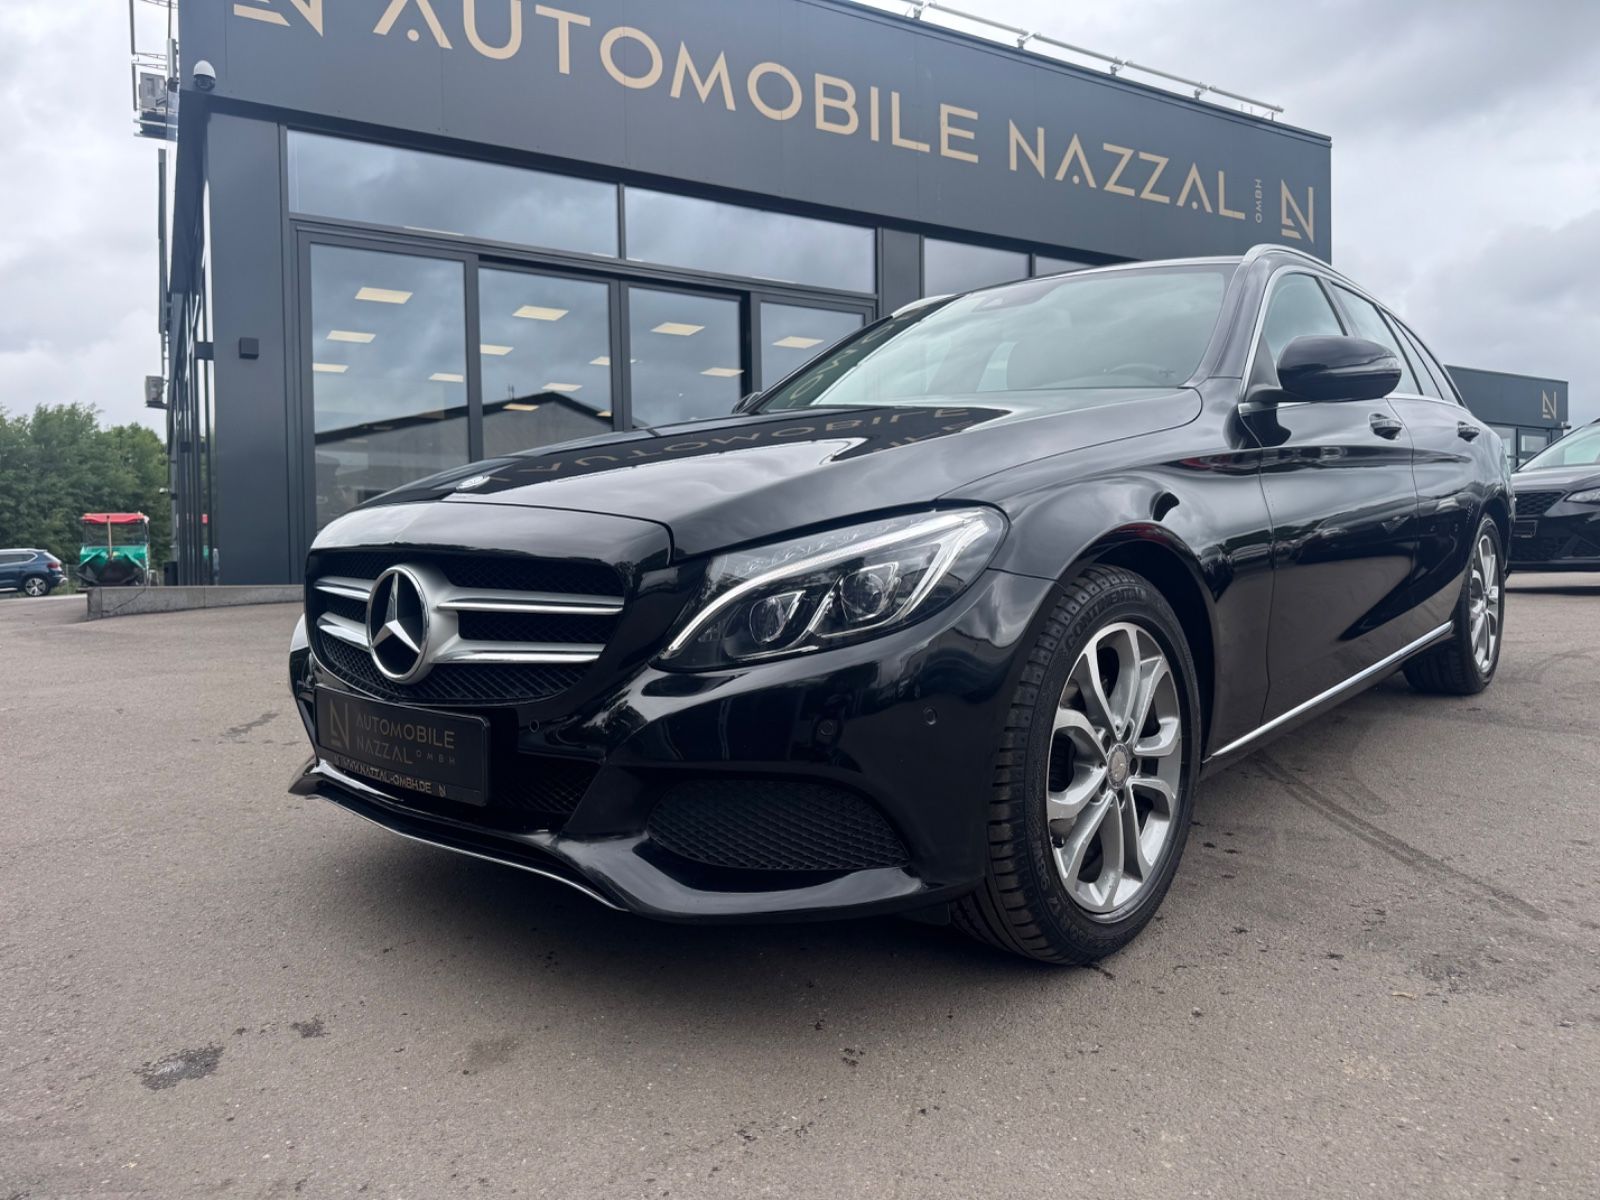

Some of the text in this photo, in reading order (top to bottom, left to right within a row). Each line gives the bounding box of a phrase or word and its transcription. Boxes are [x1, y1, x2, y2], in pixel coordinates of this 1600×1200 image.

[373, 0, 979, 164] AUTOMOBILE
[1008, 119, 1246, 220] NAZZAL
[355, 711, 456, 749] AUTOMOBILE
[356, 735, 414, 764] NAZZAL
